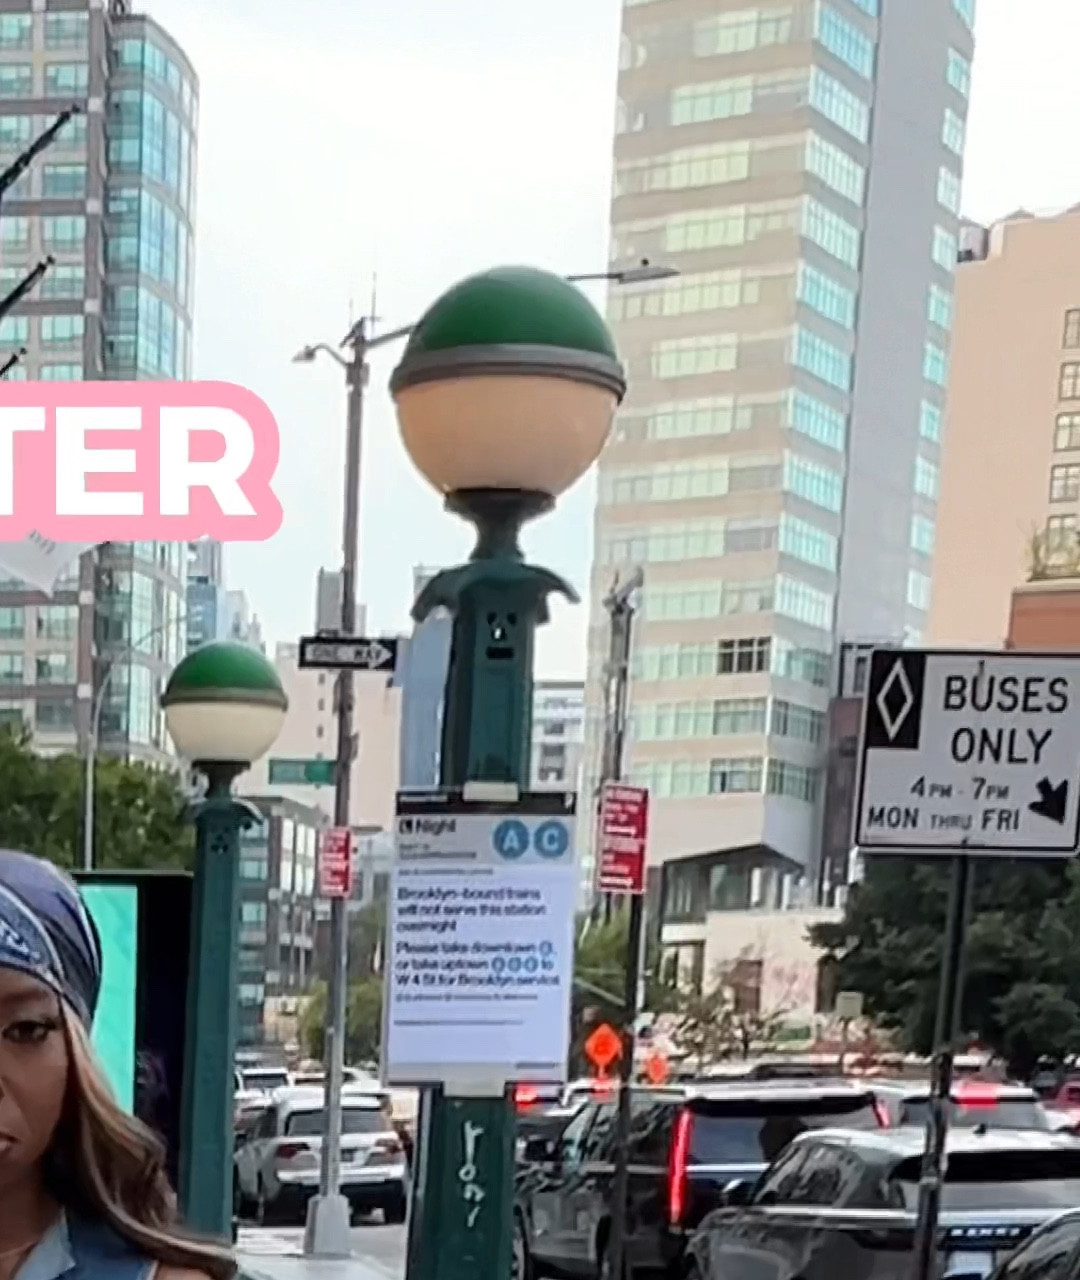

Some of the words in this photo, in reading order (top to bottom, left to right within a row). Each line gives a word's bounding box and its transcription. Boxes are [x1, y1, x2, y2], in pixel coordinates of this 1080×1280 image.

[944, 675, 1069, 713] BUSES
[951, 727, 1053, 764] ONLY
[416, 819, 456, 836] Night
[868, 805, 919, 829] MON
[930, 813, 973, 830] THRU
[981, 808, 1020, 831] FRI
